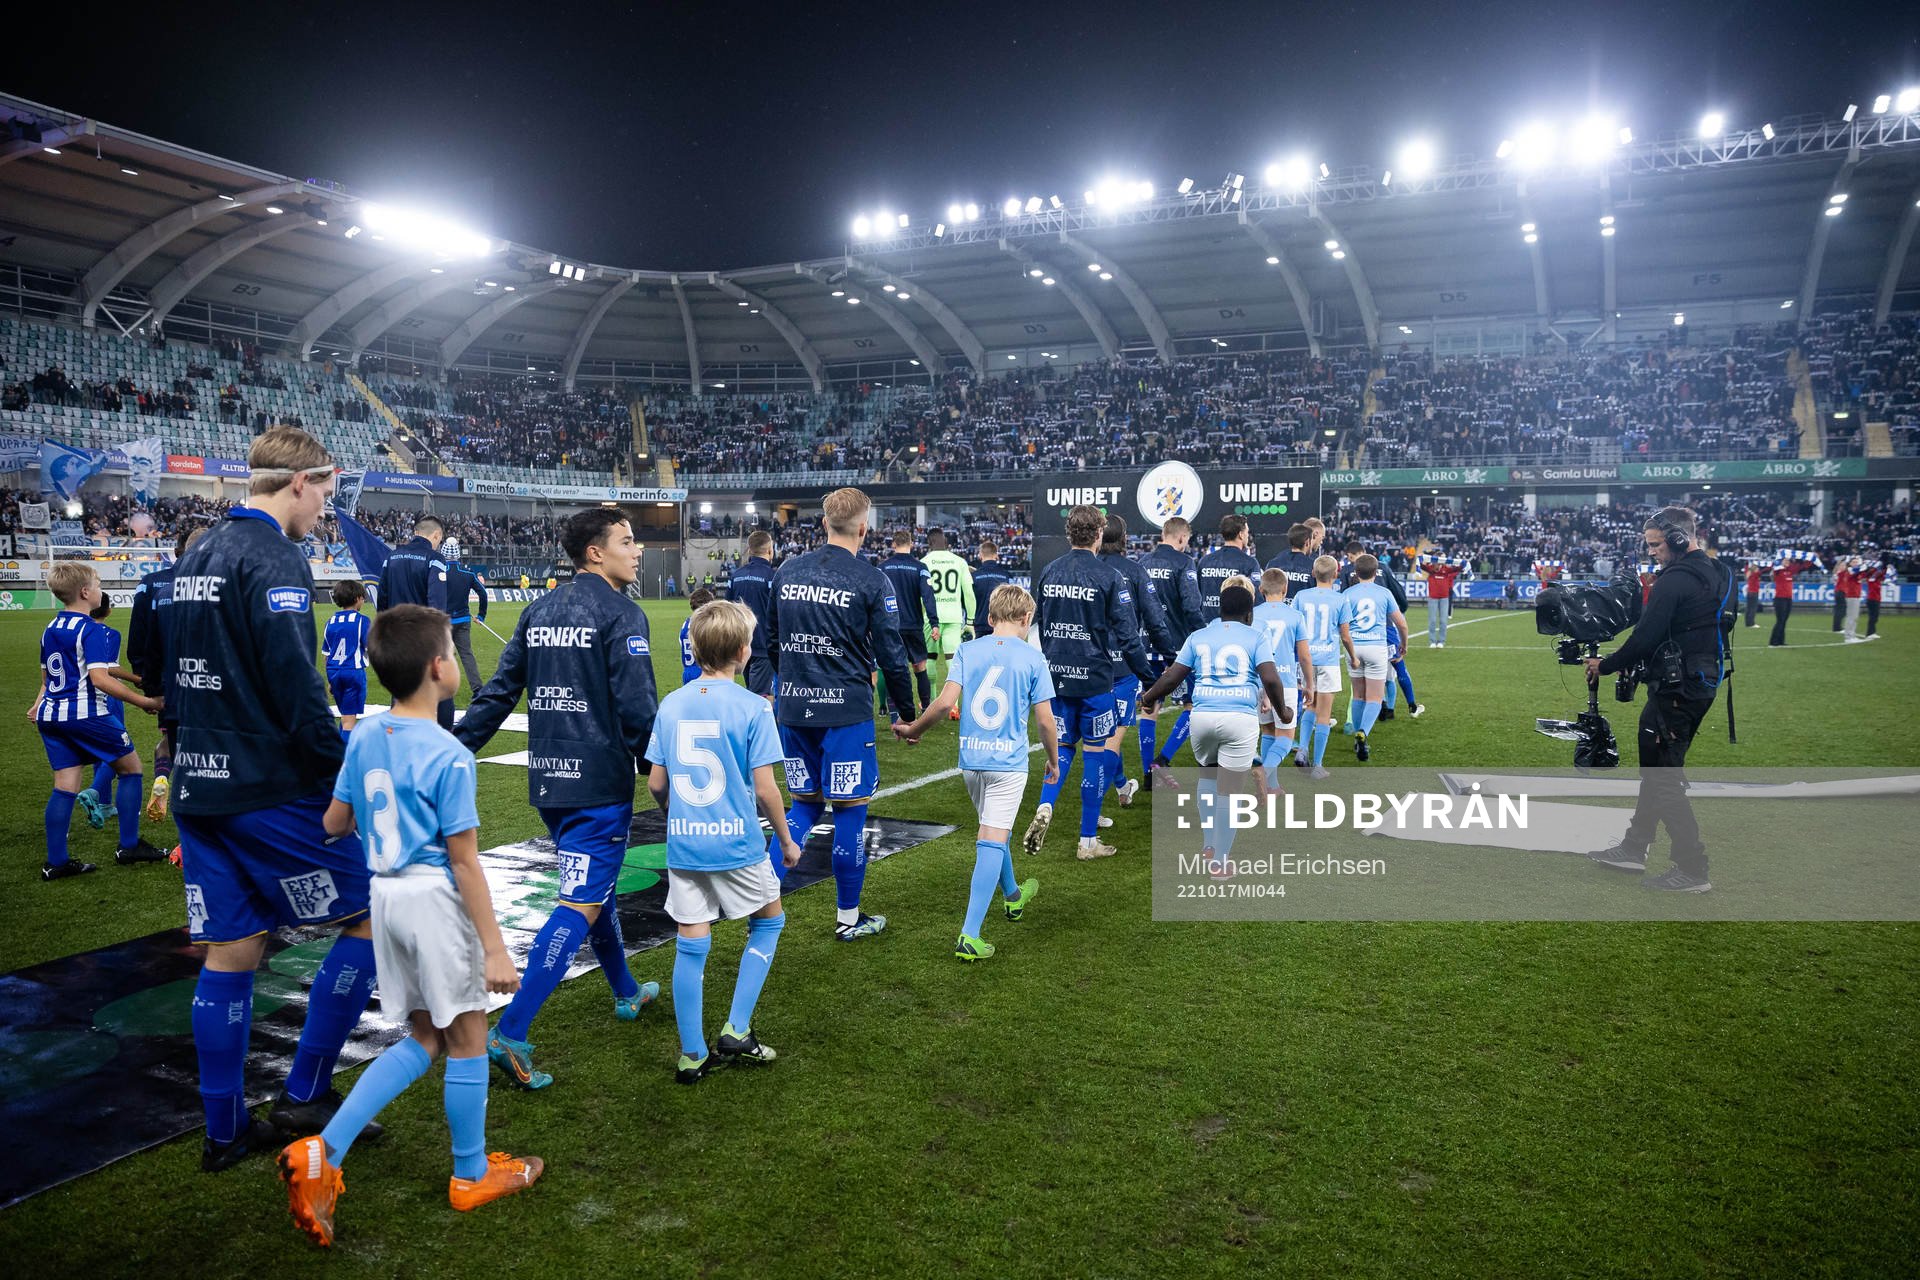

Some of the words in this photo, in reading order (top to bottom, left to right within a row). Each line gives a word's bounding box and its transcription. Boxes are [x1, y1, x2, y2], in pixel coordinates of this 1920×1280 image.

[232, 283, 261, 297] B3
[1219, 308, 1246, 320] D4
[1023, 324, 1048, 335] D3
[854, 338, 877, 349] D2
[170, 460, 202, 470] nordstan
[220, 463, 245, 473] ALLTID
[1543, 469, 1581, 480] Gamla
[1583, 467, 1617, 479] Ullevi
[404, 477, 433, 486] NORDSTAN
[476, 481, 529, 497] merinfo.se
[620, 489, 686, 501] merinfo.se
[1047, 486, 1121, 506] UNIBET
[1219, 482, 1303, 502] UNIBET
[489, 565, 538, 579] OLIVEDAL
[1149, 568, 1170, 580] NEKE
[1201, 567, 1239, 577] SERNEKE
[1284, 571, 1309, 582] NEKE
[930, 568, 959, 594] 30
[173, 576, 222, 602] ERNEKE
[780, 583, 852, 608] SERNEKE
[1043, 584, 1095, 602] SERNEKE
[271, 591, 307, 603] UNIBET
[1304, 602, 1329, 641] 11
[1355, 598, 1376, 631] 8
[1050, 622, 1084, 632] NORDIC
[526, 626, 593, 649] SERNEKE
[790, 633, 832, 646] NORDIC
[1043, 629, 1091, 641] WELLNESS
[1267, 619, 1286, 650] 7
[332, 637, 348, 666] 4
[780, 643, 844, 657] WELLNESS
[46, 652, 66, 693] 9
[970, 665, 1009, 731] 6
[1195, 686, 1250, 699] Tillmobil
[959, 736, 1013, 752] Tillmobil
[672, 720, 727, 807] 5
[833, 763, 857, 774] EFF
[554, 771, 581, 779] INSTALCO
[833, 772, 858, 783] EKT
[833, 781, 847, 793] IV
[363, 768, 402, 872] 3
[670, 818, 745, 836] illmobil
[286, 873, 322, 893] EFF
[291, 884, 331, 905] EKT
[296, 901, 317, 917] IV
